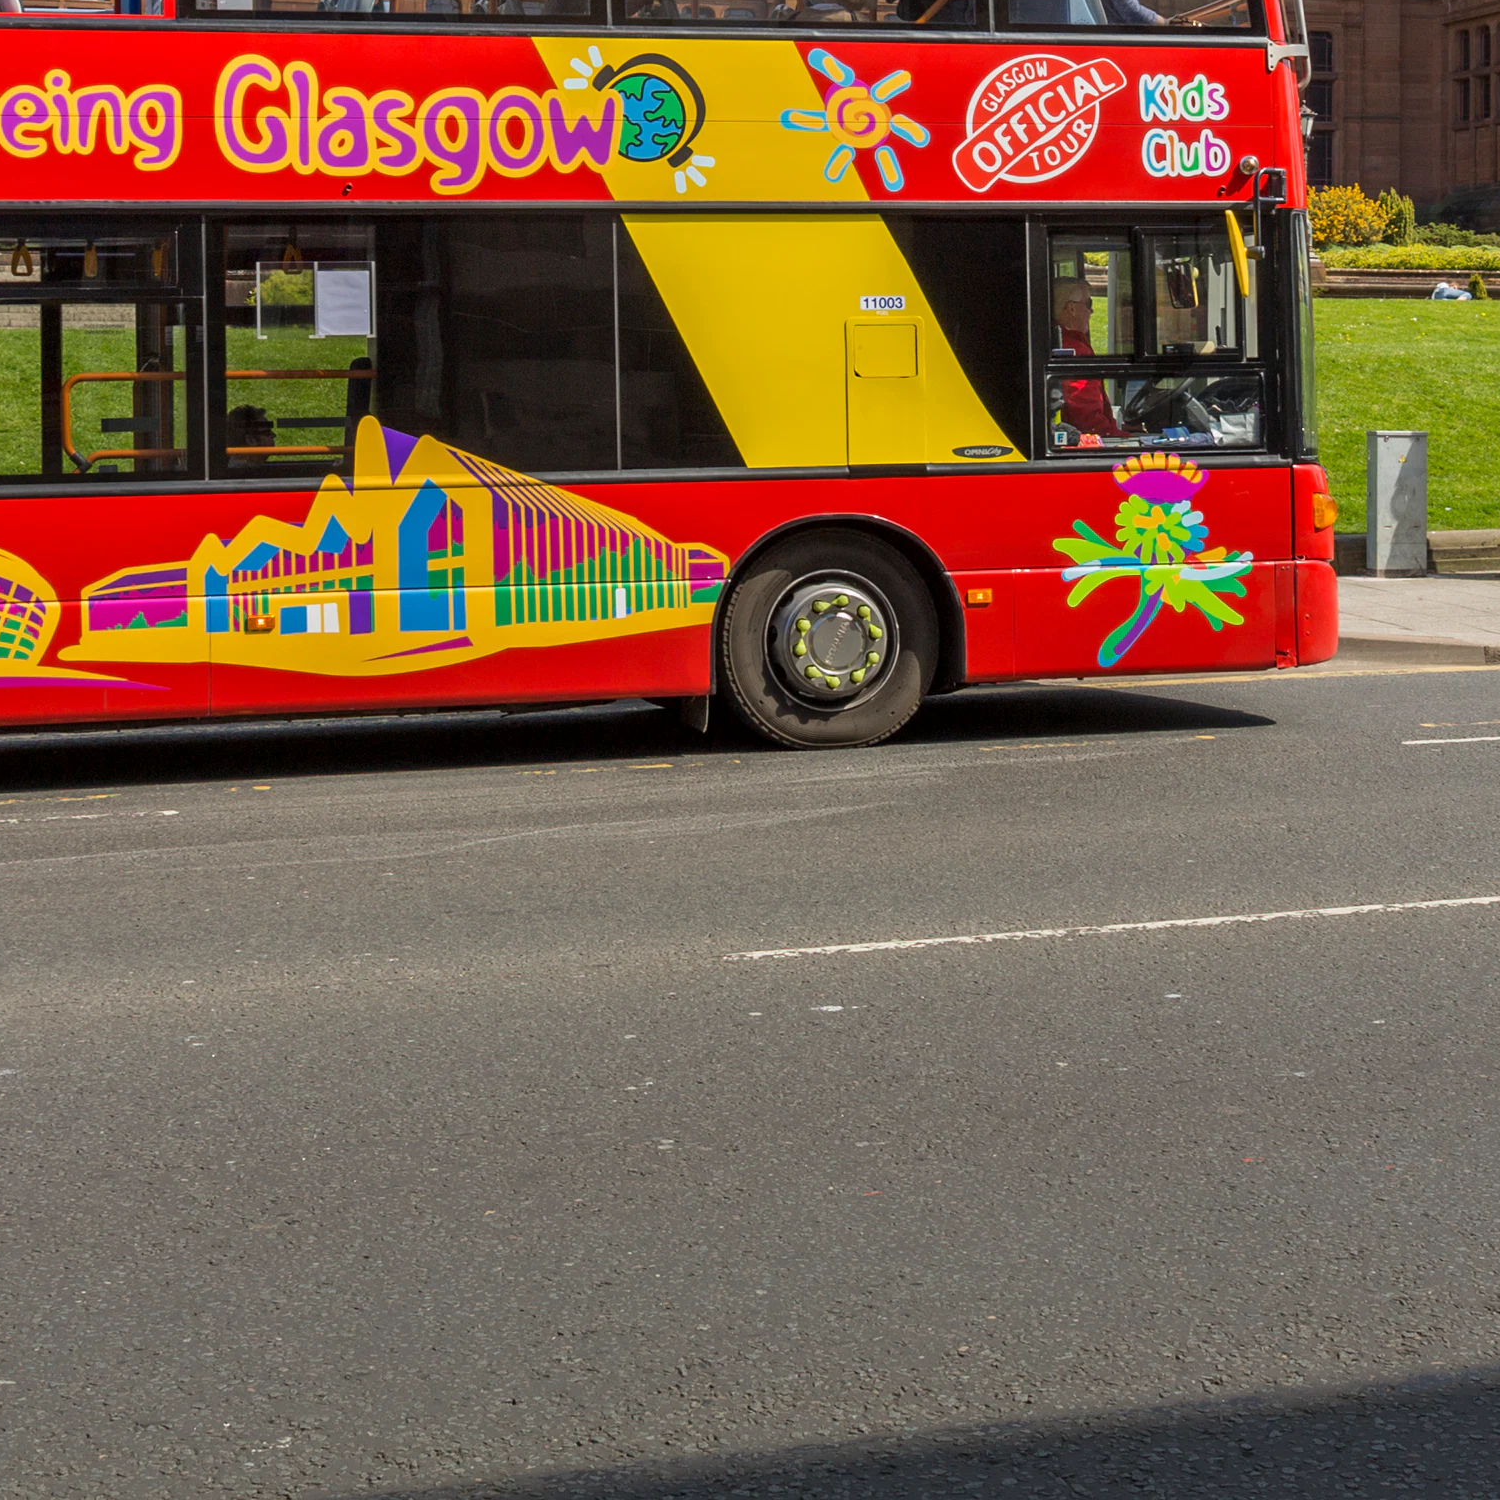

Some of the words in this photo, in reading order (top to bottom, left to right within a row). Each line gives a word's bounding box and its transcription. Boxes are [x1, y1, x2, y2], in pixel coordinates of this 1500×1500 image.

[981, 60, 1047, 113] GLASGOW
[1139, 73, 1229, 122] Kids
[214, 53, 622, 195] Glasgow
[972, 67, 1116, 173] OFFICIAL
[1028, 118, 1093, 171] TOUR
[1141, 127, 1231, 177] Club
[863, 297, 903, 309] 11003
